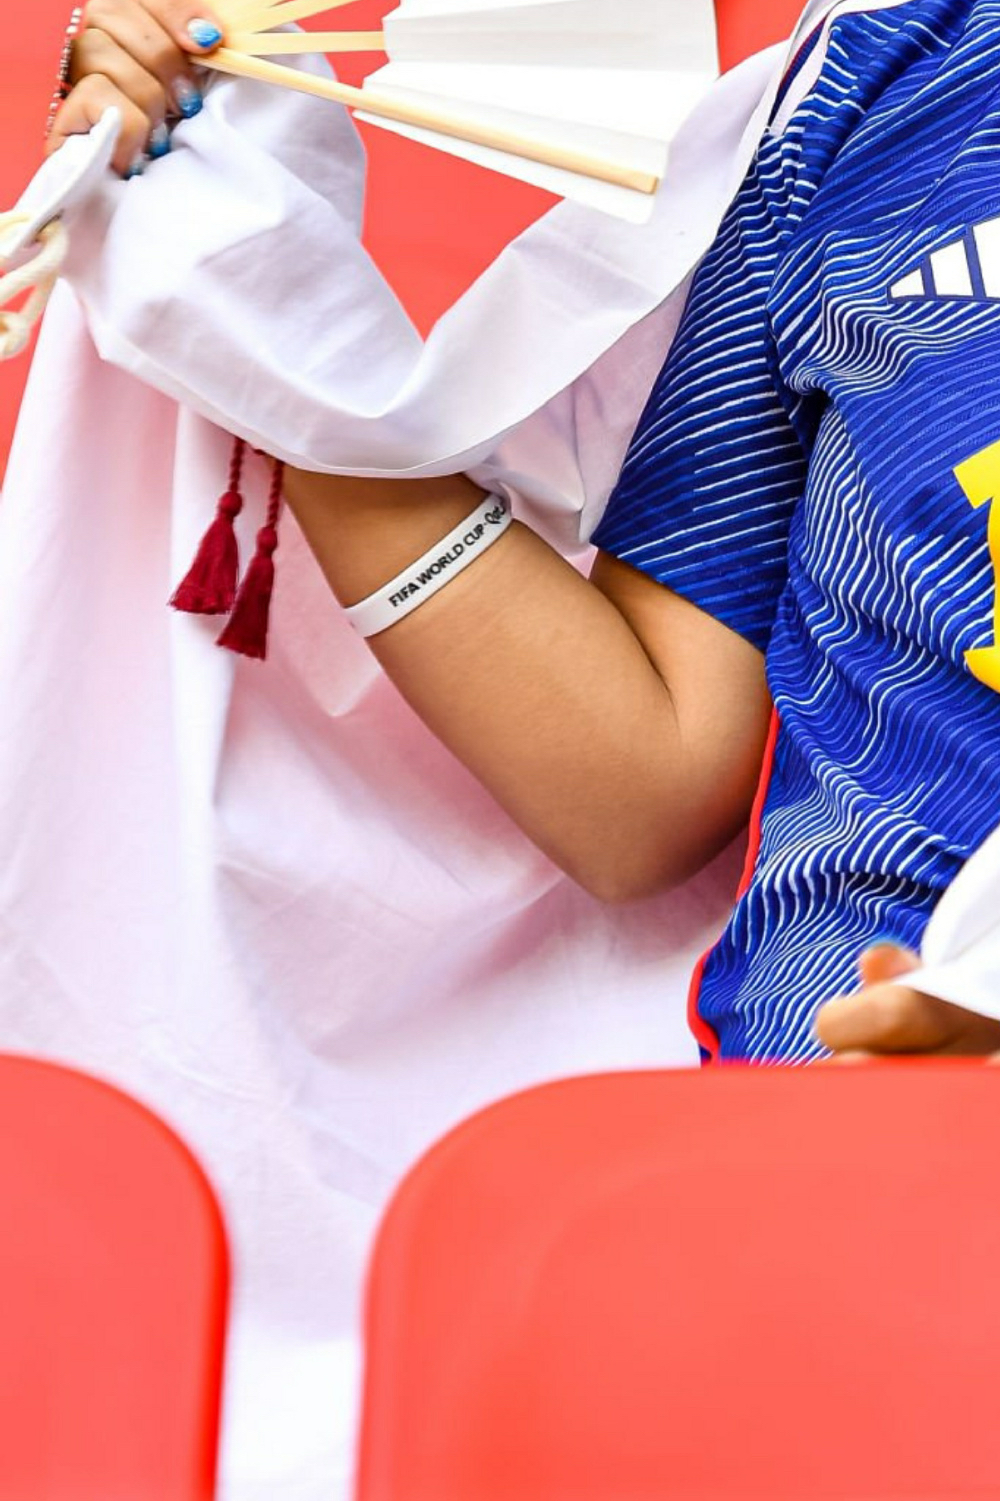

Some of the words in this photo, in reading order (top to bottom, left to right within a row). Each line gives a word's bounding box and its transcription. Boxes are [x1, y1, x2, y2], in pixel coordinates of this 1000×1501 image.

[388, 582, 420, 607] FIFA
[416, 543, 464, 585] WORLD
[463, 523, 484, 547] CUP
